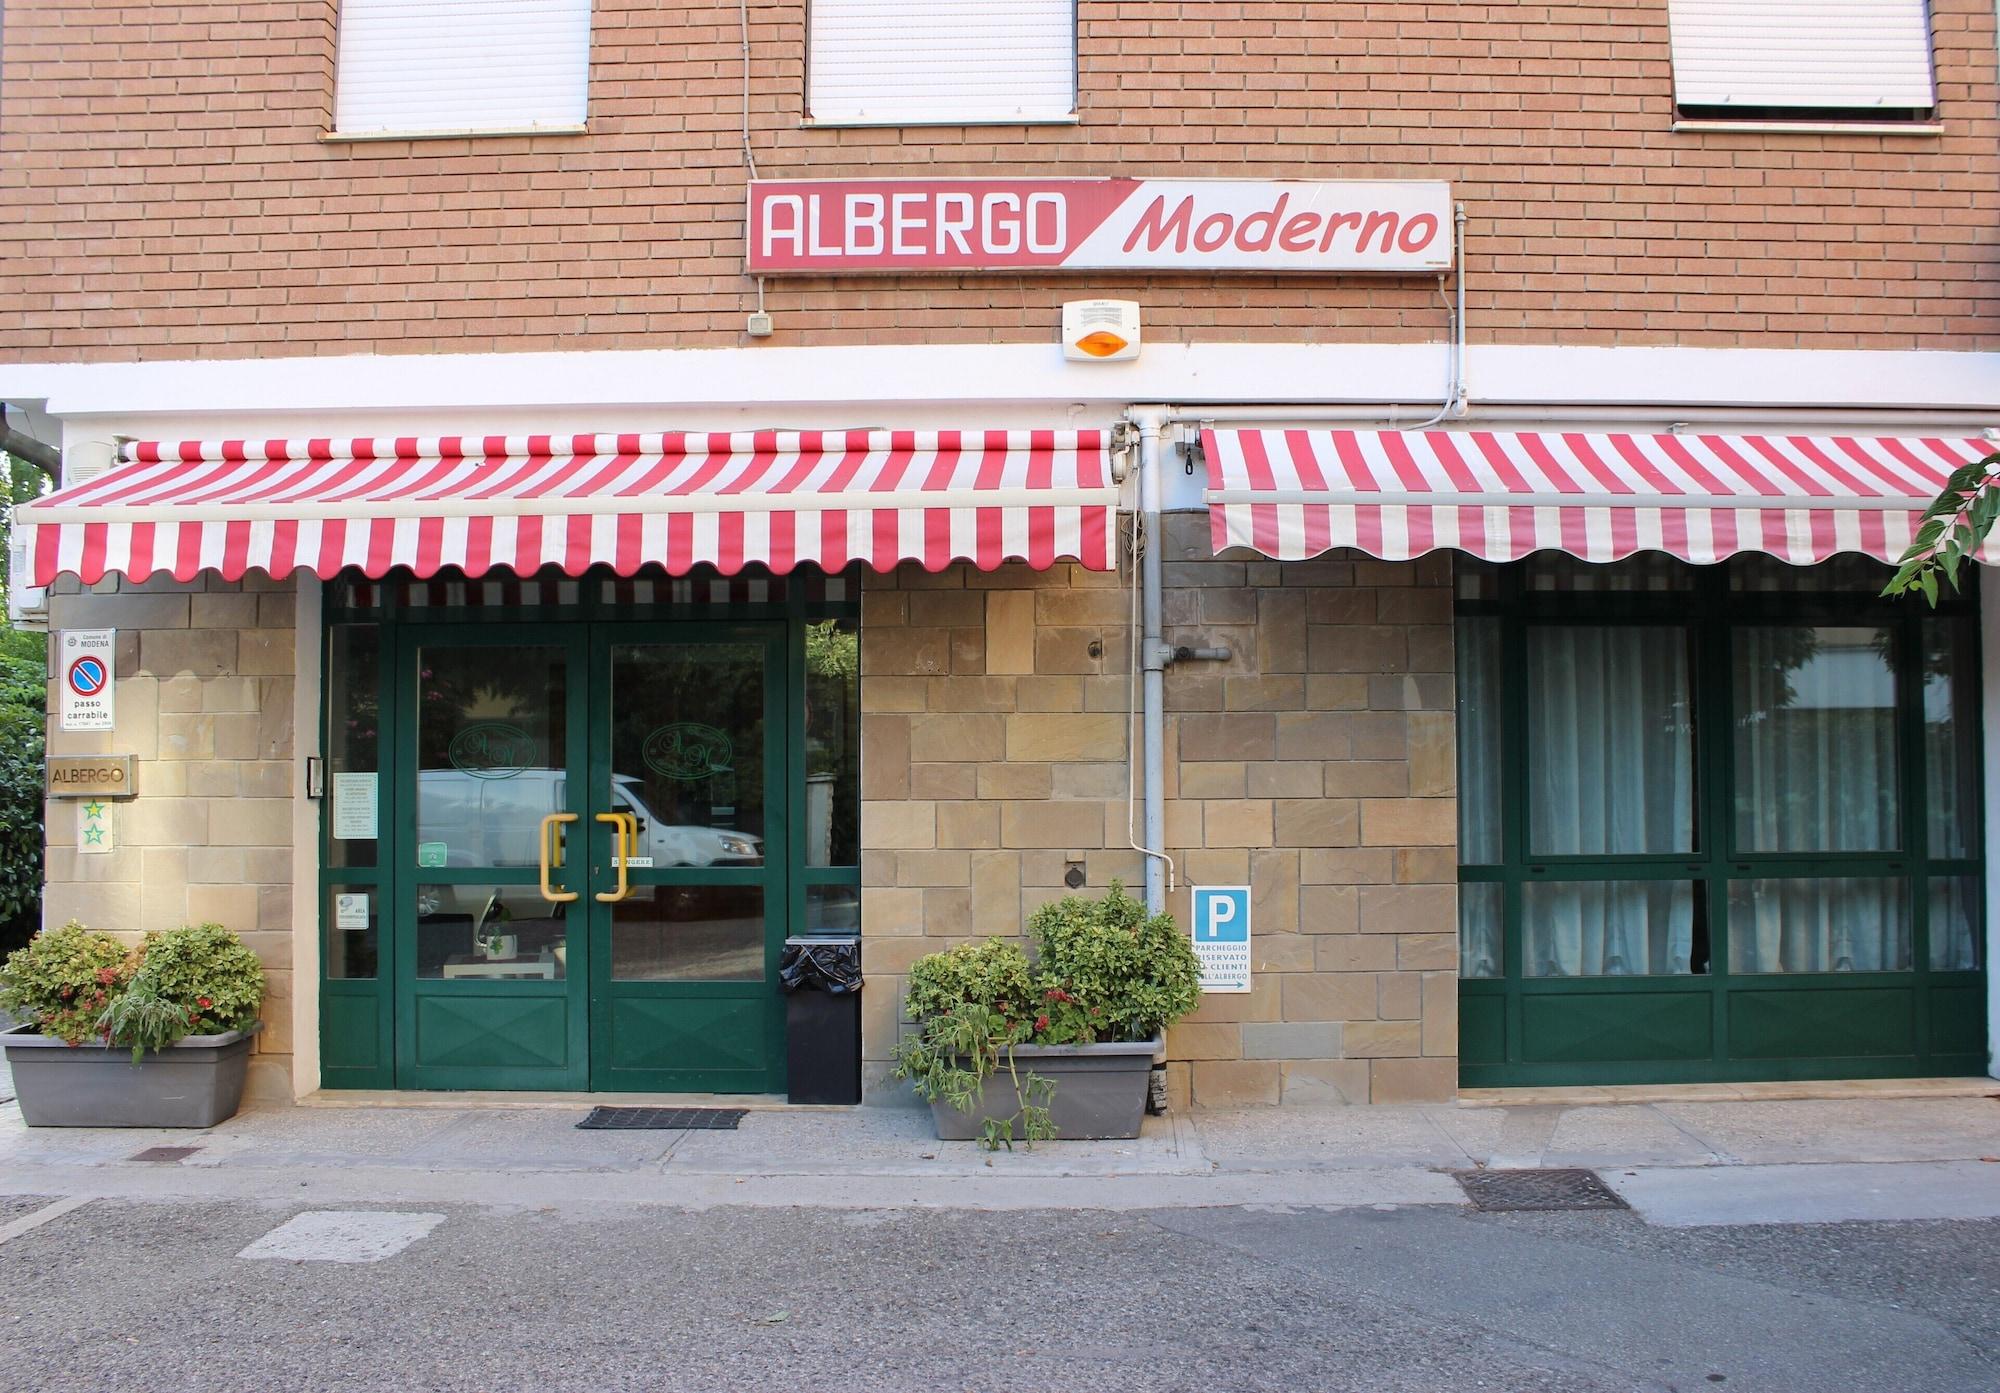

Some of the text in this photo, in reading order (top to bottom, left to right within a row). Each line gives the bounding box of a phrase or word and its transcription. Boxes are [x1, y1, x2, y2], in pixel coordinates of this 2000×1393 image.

[762, 192, 1438, 257] ALBERGO Moderno
[80, 640, 110, 648] MODENA
[67, 711, 108, 719] carrabile
[52, 768, 124, 783] ALBERGO
[1209, 895, 1236, 937] P
[1195, 944, 1247, 952] PARCHEGGIO
